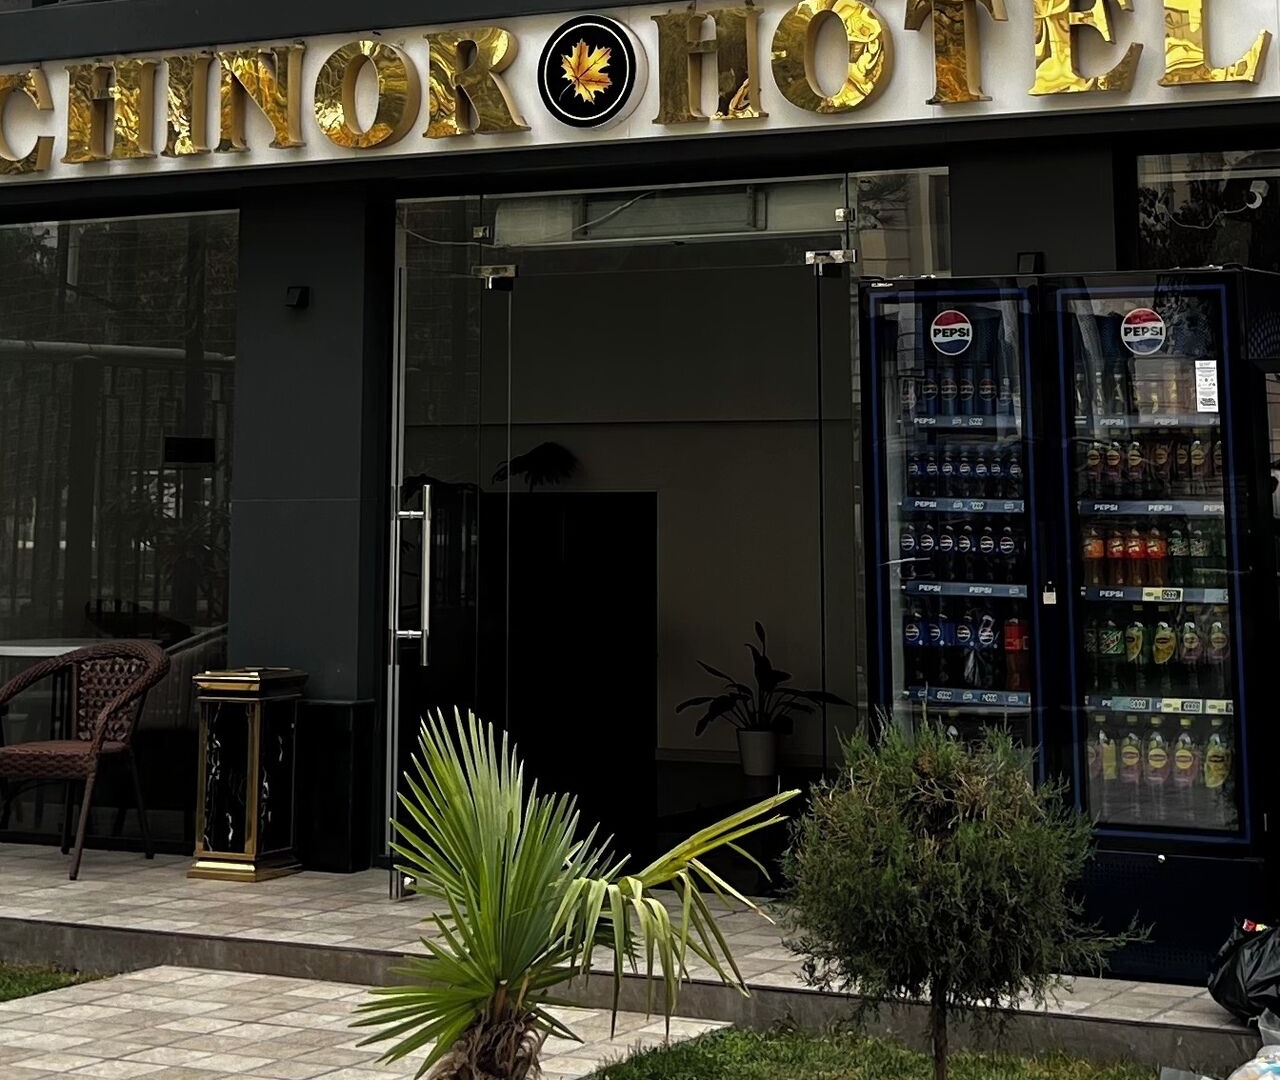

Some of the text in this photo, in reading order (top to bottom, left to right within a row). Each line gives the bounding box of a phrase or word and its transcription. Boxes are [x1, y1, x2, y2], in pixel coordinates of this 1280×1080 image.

[932, 327, 970, 338] PEPSI
[1123, 326, 1163, 337] PEPSI
[1093, 503, 1119, 512] PEPSI
[1147, 504, 1173, 512] PEPSI
[918, 584, 941, 592] PEPSI
[968, 586, 992, 594] PEPSI
[1098, 589, 1124, 598] PEPSI
